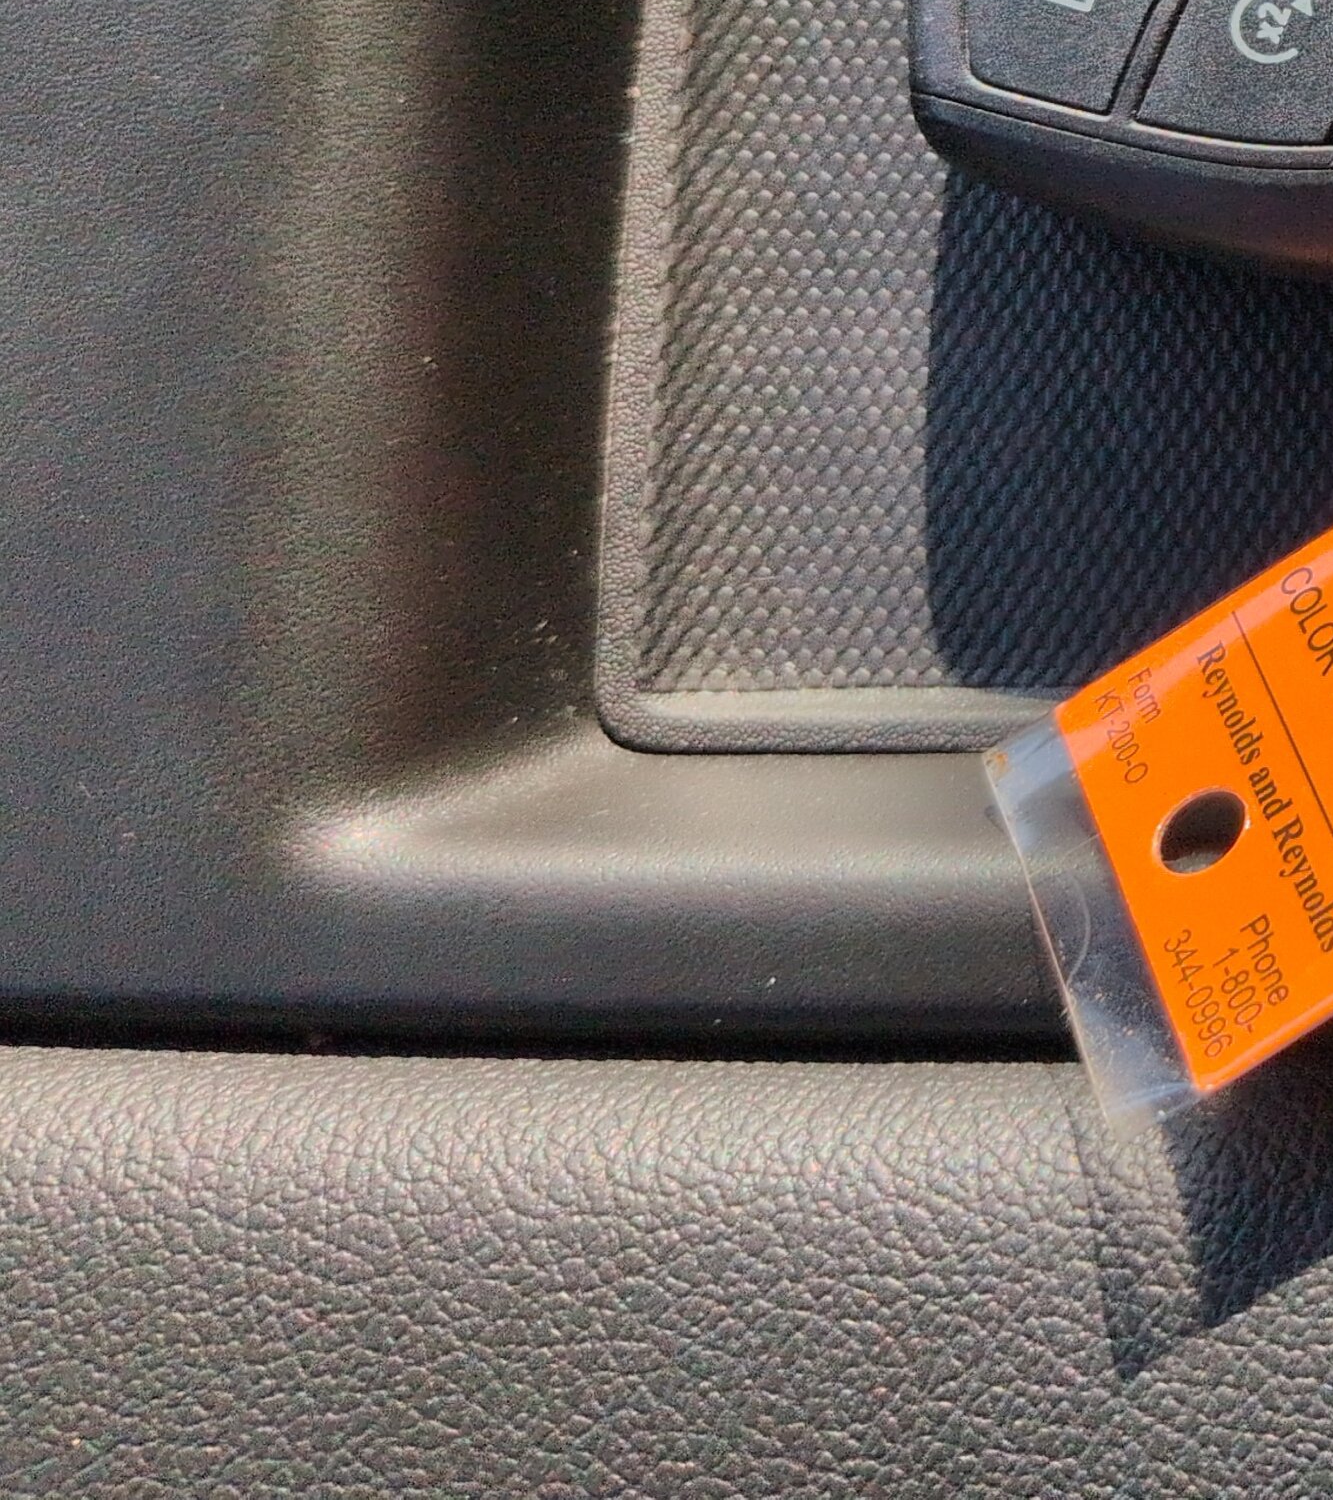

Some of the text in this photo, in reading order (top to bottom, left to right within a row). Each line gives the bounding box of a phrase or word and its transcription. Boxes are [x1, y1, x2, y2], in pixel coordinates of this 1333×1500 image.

[1127, 667, 1162, 725] Form
[1196, 642, 1262, 766] Reynolds
[1246, 770, 1290, 822] and
[1163, 928, 1233, 1059] 344-0996
[1240, 914, 1290, 1006] Phone
